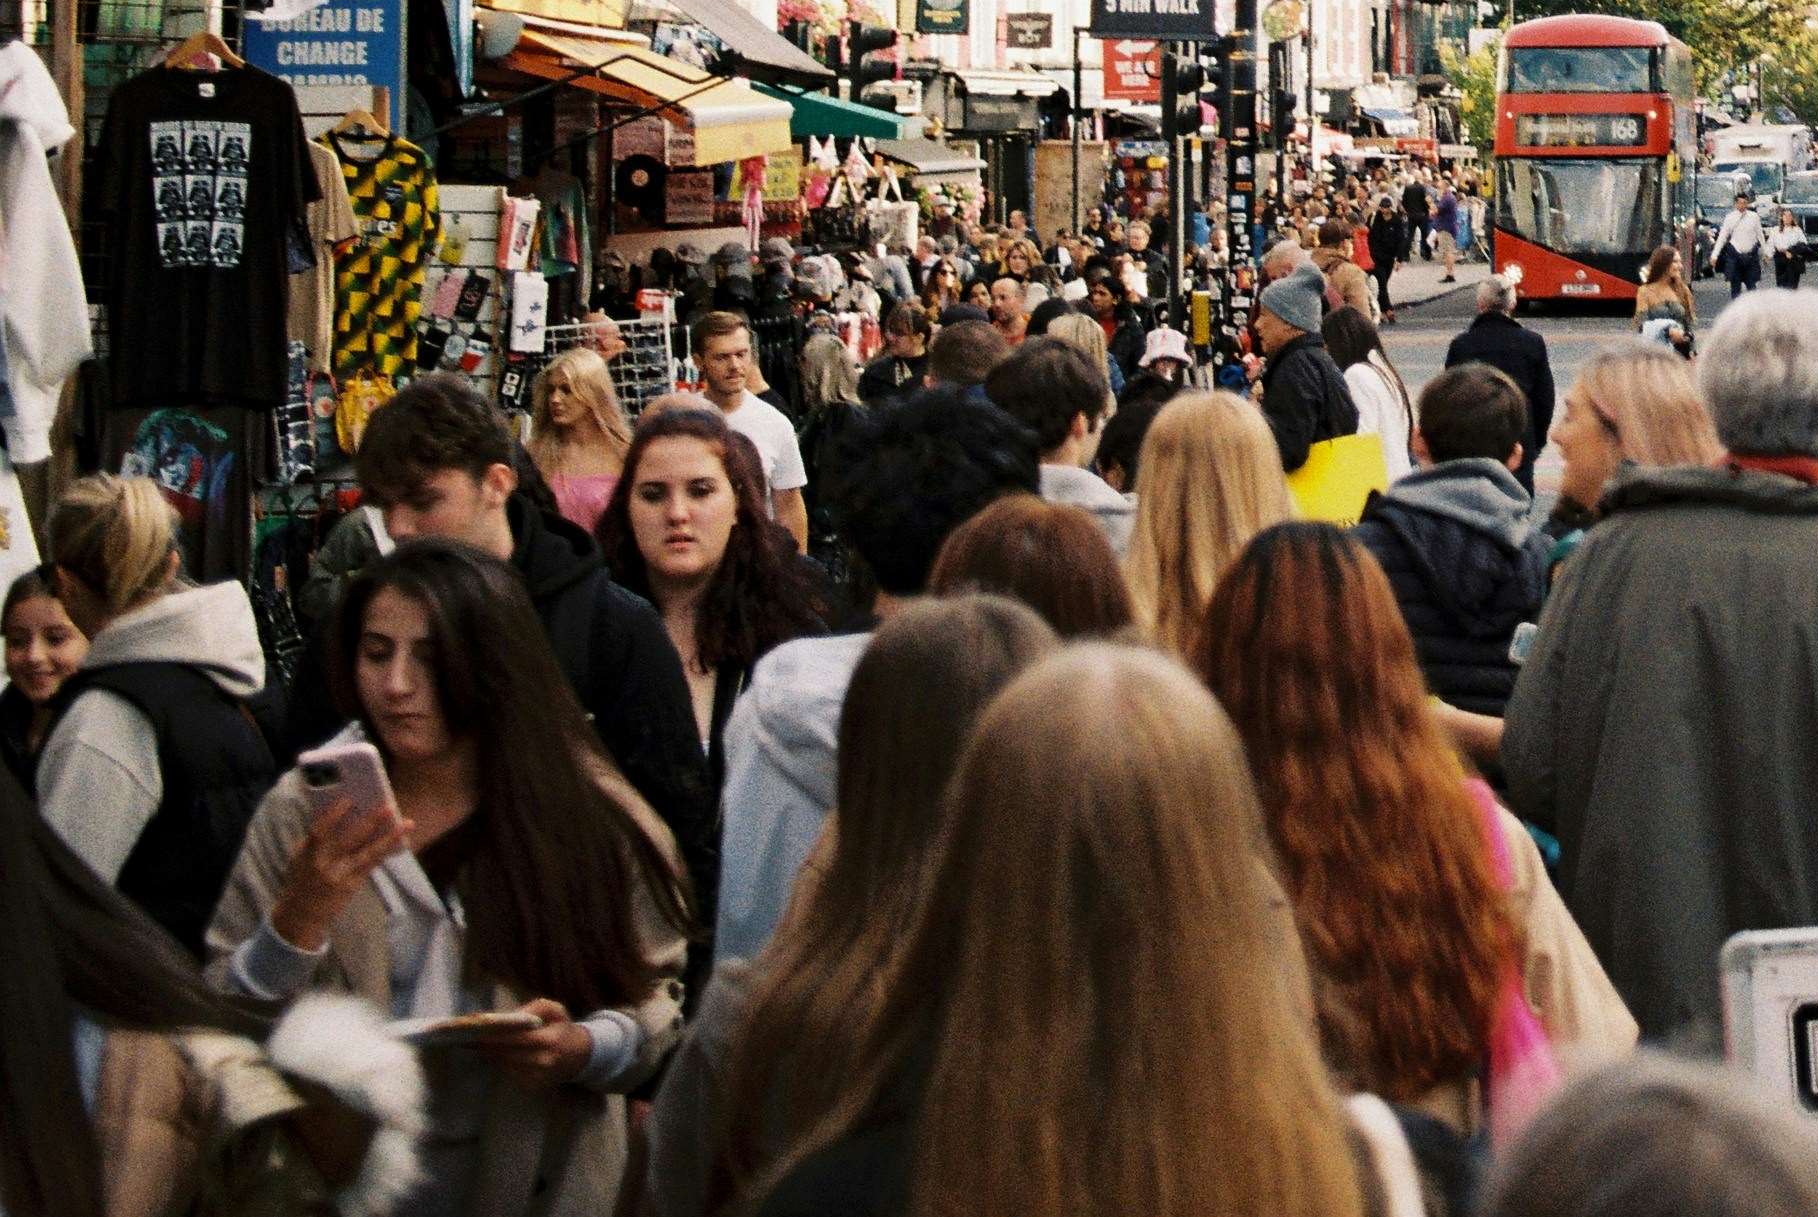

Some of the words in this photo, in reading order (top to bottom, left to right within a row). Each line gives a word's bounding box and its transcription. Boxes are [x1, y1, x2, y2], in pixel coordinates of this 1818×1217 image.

[356, 8, 385, 32] DE
[276, 41, 369, 66] CHANGE
[1611, 118, 1638, 141] 168
